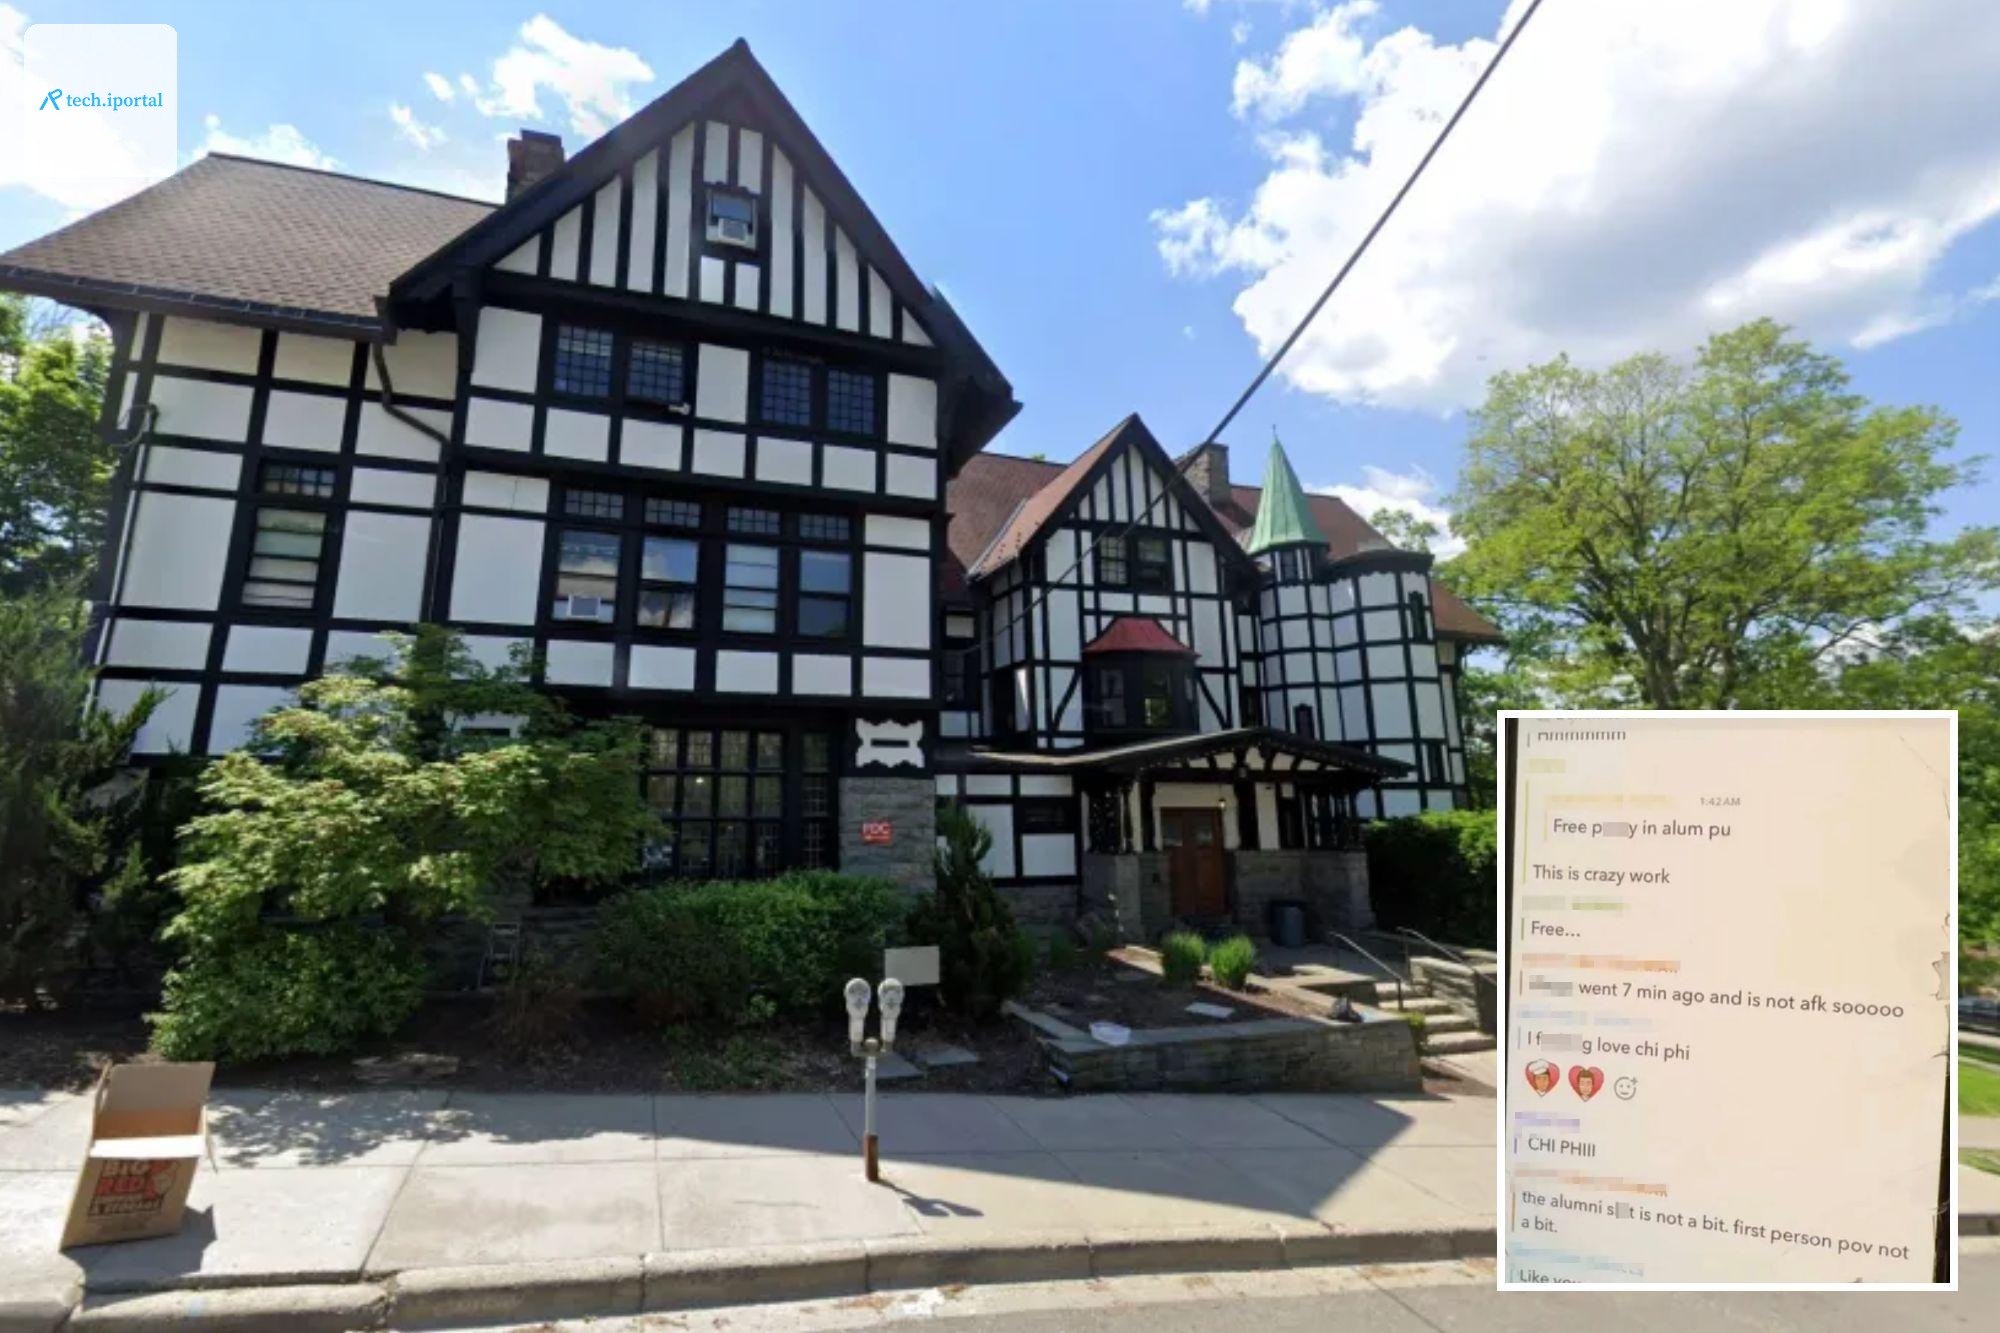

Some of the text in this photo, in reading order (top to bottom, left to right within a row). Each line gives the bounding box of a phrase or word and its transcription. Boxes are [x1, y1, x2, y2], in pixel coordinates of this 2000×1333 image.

[1553, 818, 1587, 834] Free
[1642, 820, 1657, 835] in
[1662, 820, 1703, 836] alum
[1709, 824, 1731, 840] pu
[1533, 864, 1671, 886] This is crazy work
[1530, 921, 1581, 938] Free...
[1579, 982, 1618, 997] went
[1622, 982, 1632, 997] 7
[1637, 985, 1667, 1000] min
[1672, 990, 1705, 1006] ago
[1709, 990, 1742, 1006] and
[1747, 991, 1761, 1008] is
[1765, 995, 1795, 1010] not
[1800, 995, 1827, 1012] afk
[1832, 1001, 1904, 1018] sooooo
[1597, 1037, 1631, 1055] love
[1635, 1041, 1659, 1057] chi
[1664, 1043, 1690, 1062] phi
[1528, 1136, 1596, 1157] CHI PHIII
[1521, 1215, 1558, 1233] a bit.
[1521, 1191, 1910, 1260] the alumni st is not a bit. first person pov not
[1519, 1268, 1550, 1283] Like
